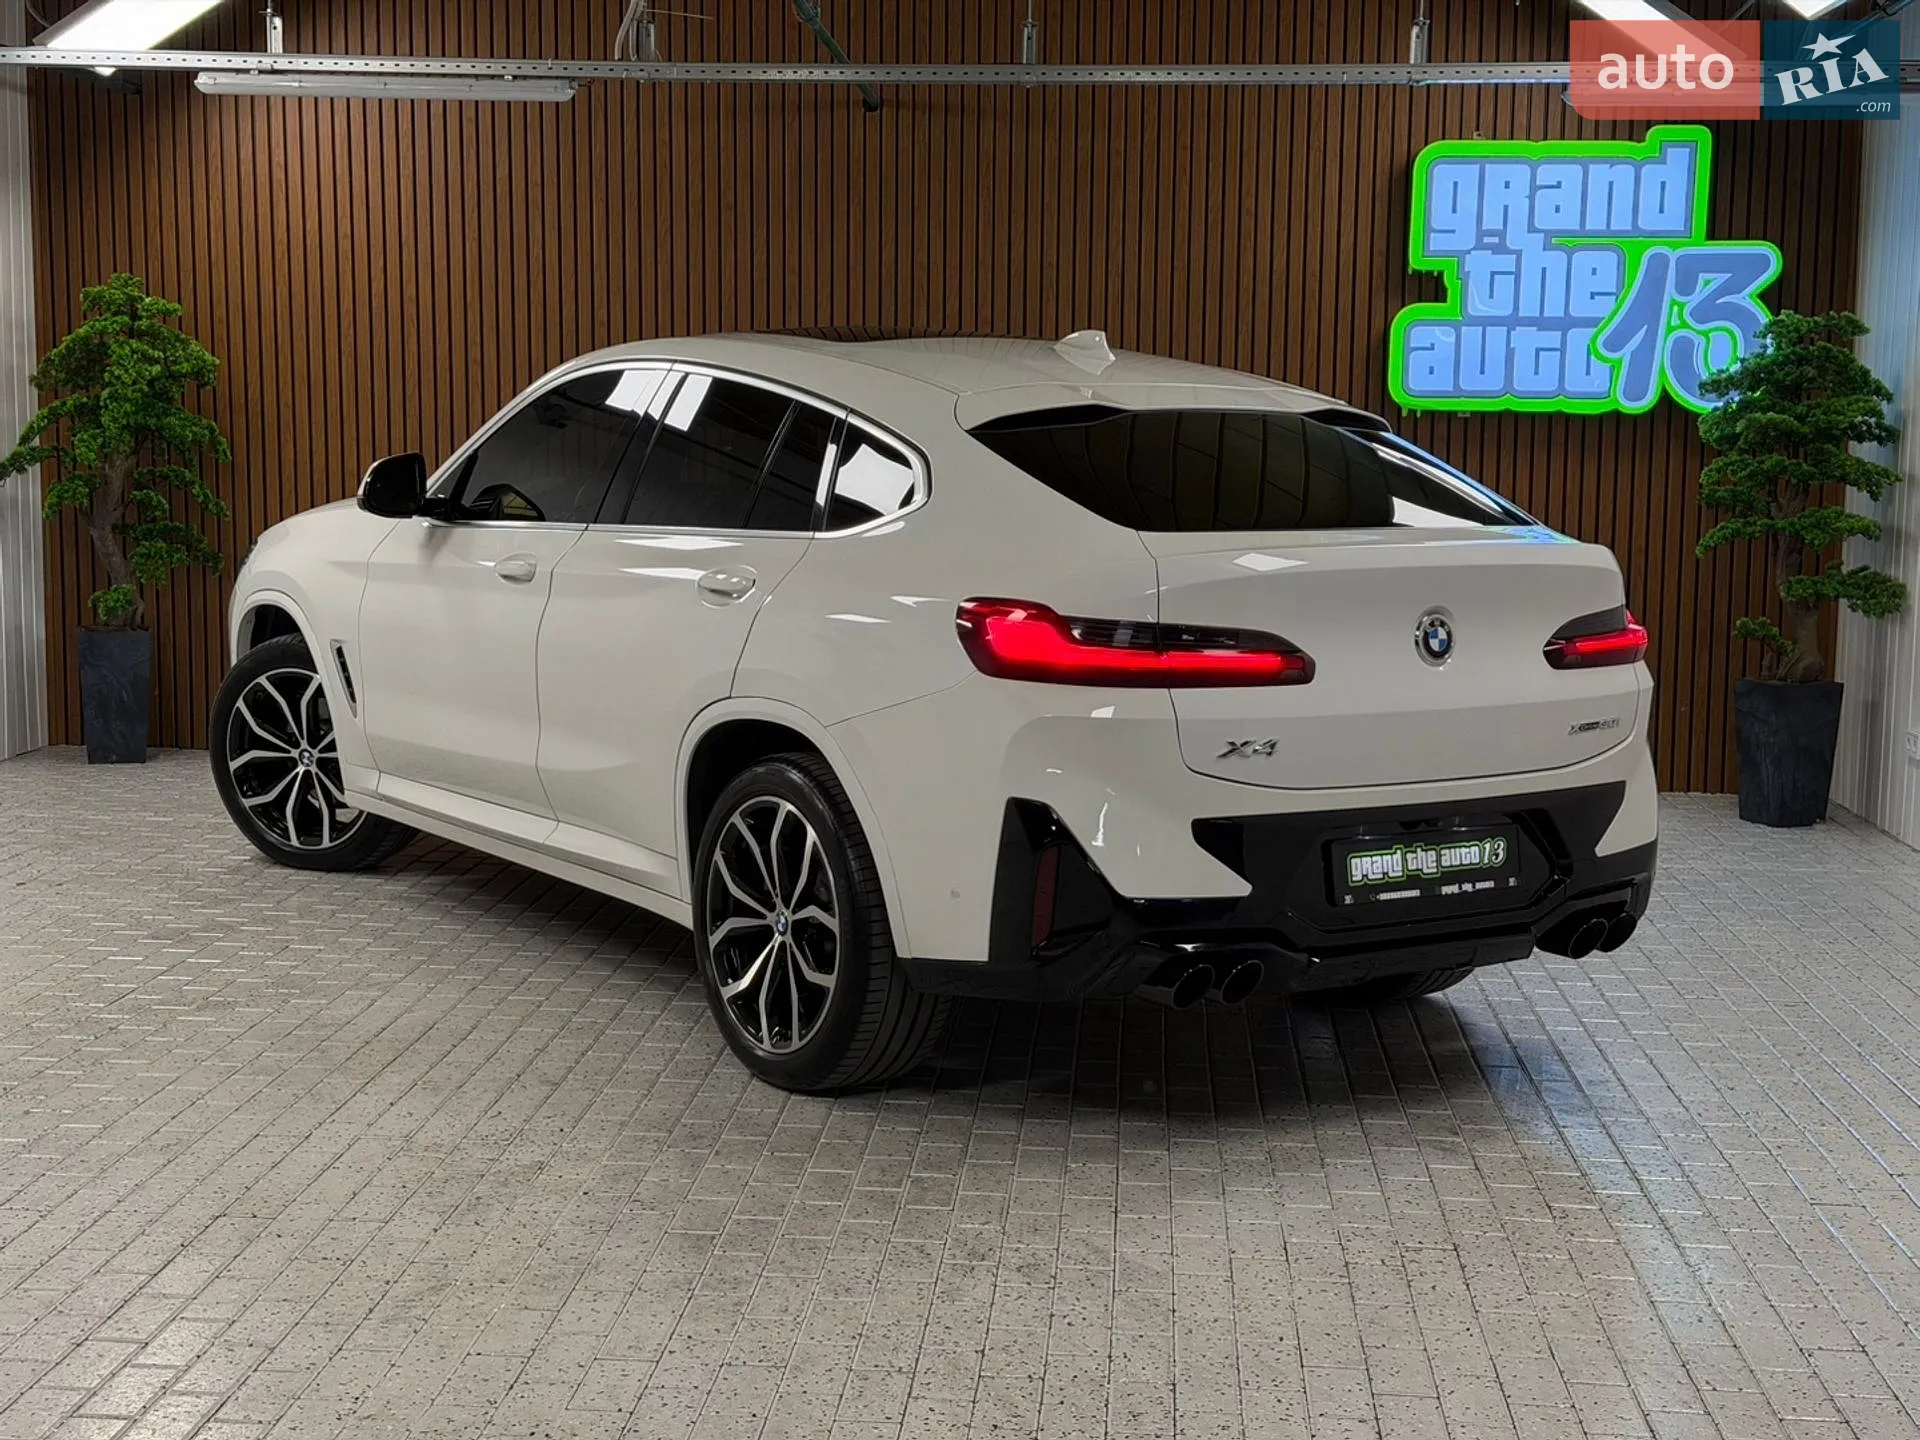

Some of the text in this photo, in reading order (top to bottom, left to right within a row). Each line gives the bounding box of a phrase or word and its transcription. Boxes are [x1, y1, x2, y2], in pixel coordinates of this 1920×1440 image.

[1428, 147, 1691, 251] grand
[1465, 232, 1619, 318] the
[1216, 739, 1278, 759] X4
[1350, 850, 1403, 882] grand
[1405, 847, 1438, 874] the
